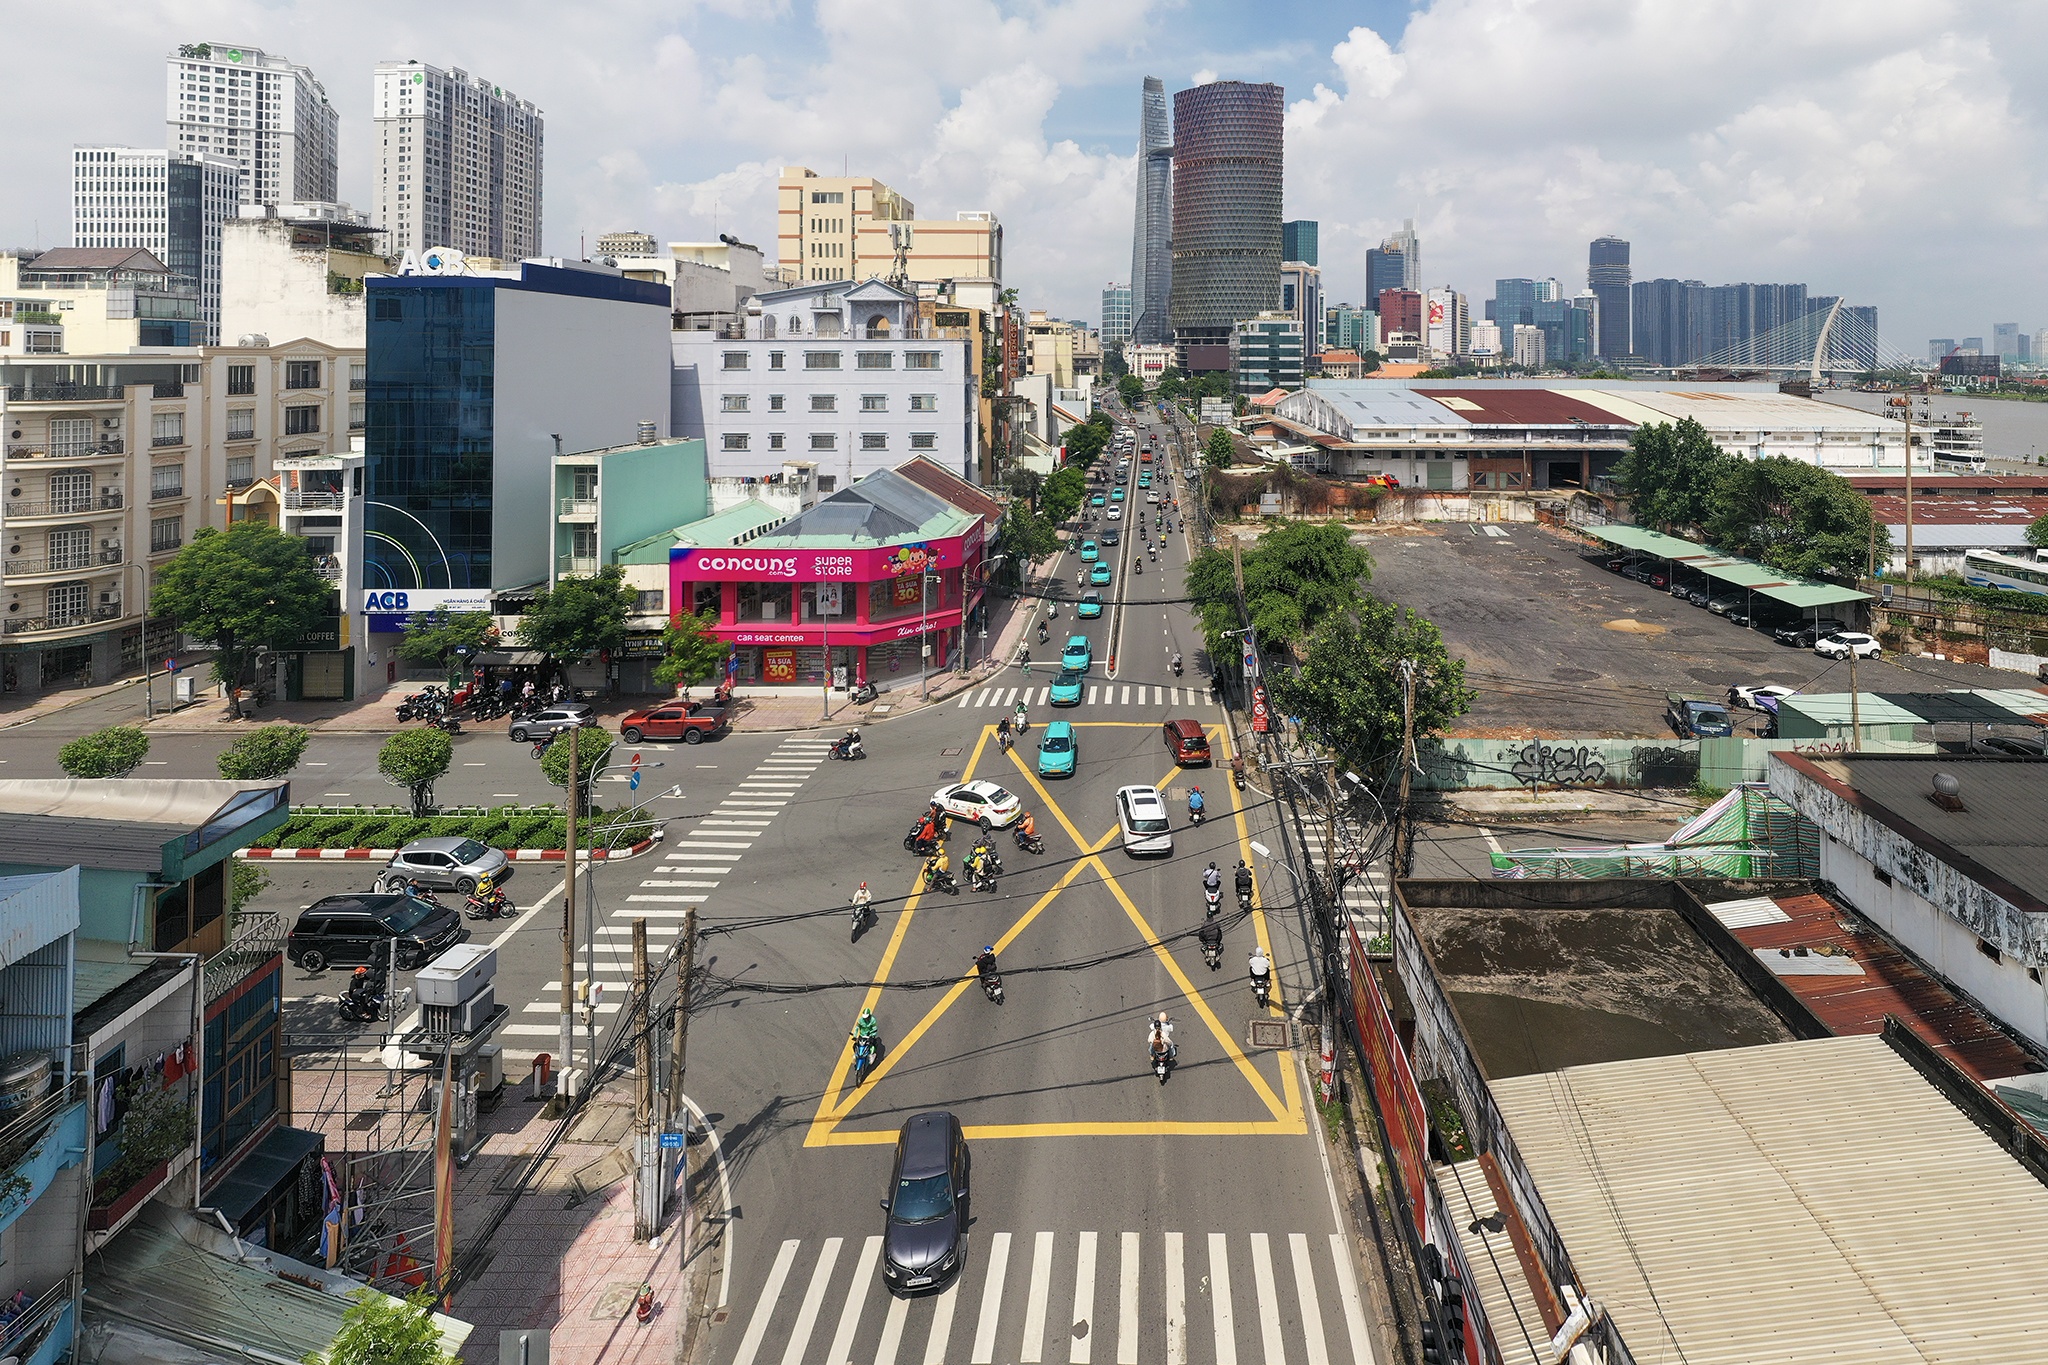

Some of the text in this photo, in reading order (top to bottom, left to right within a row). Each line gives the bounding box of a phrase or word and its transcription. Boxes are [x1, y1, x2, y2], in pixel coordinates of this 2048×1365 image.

[397, 246, 464, 276] ACB
[365, 591, 409, 610] ACB
[306, 631, 335, 641] COFFEE
[897, 627, 914, 637] Xin
